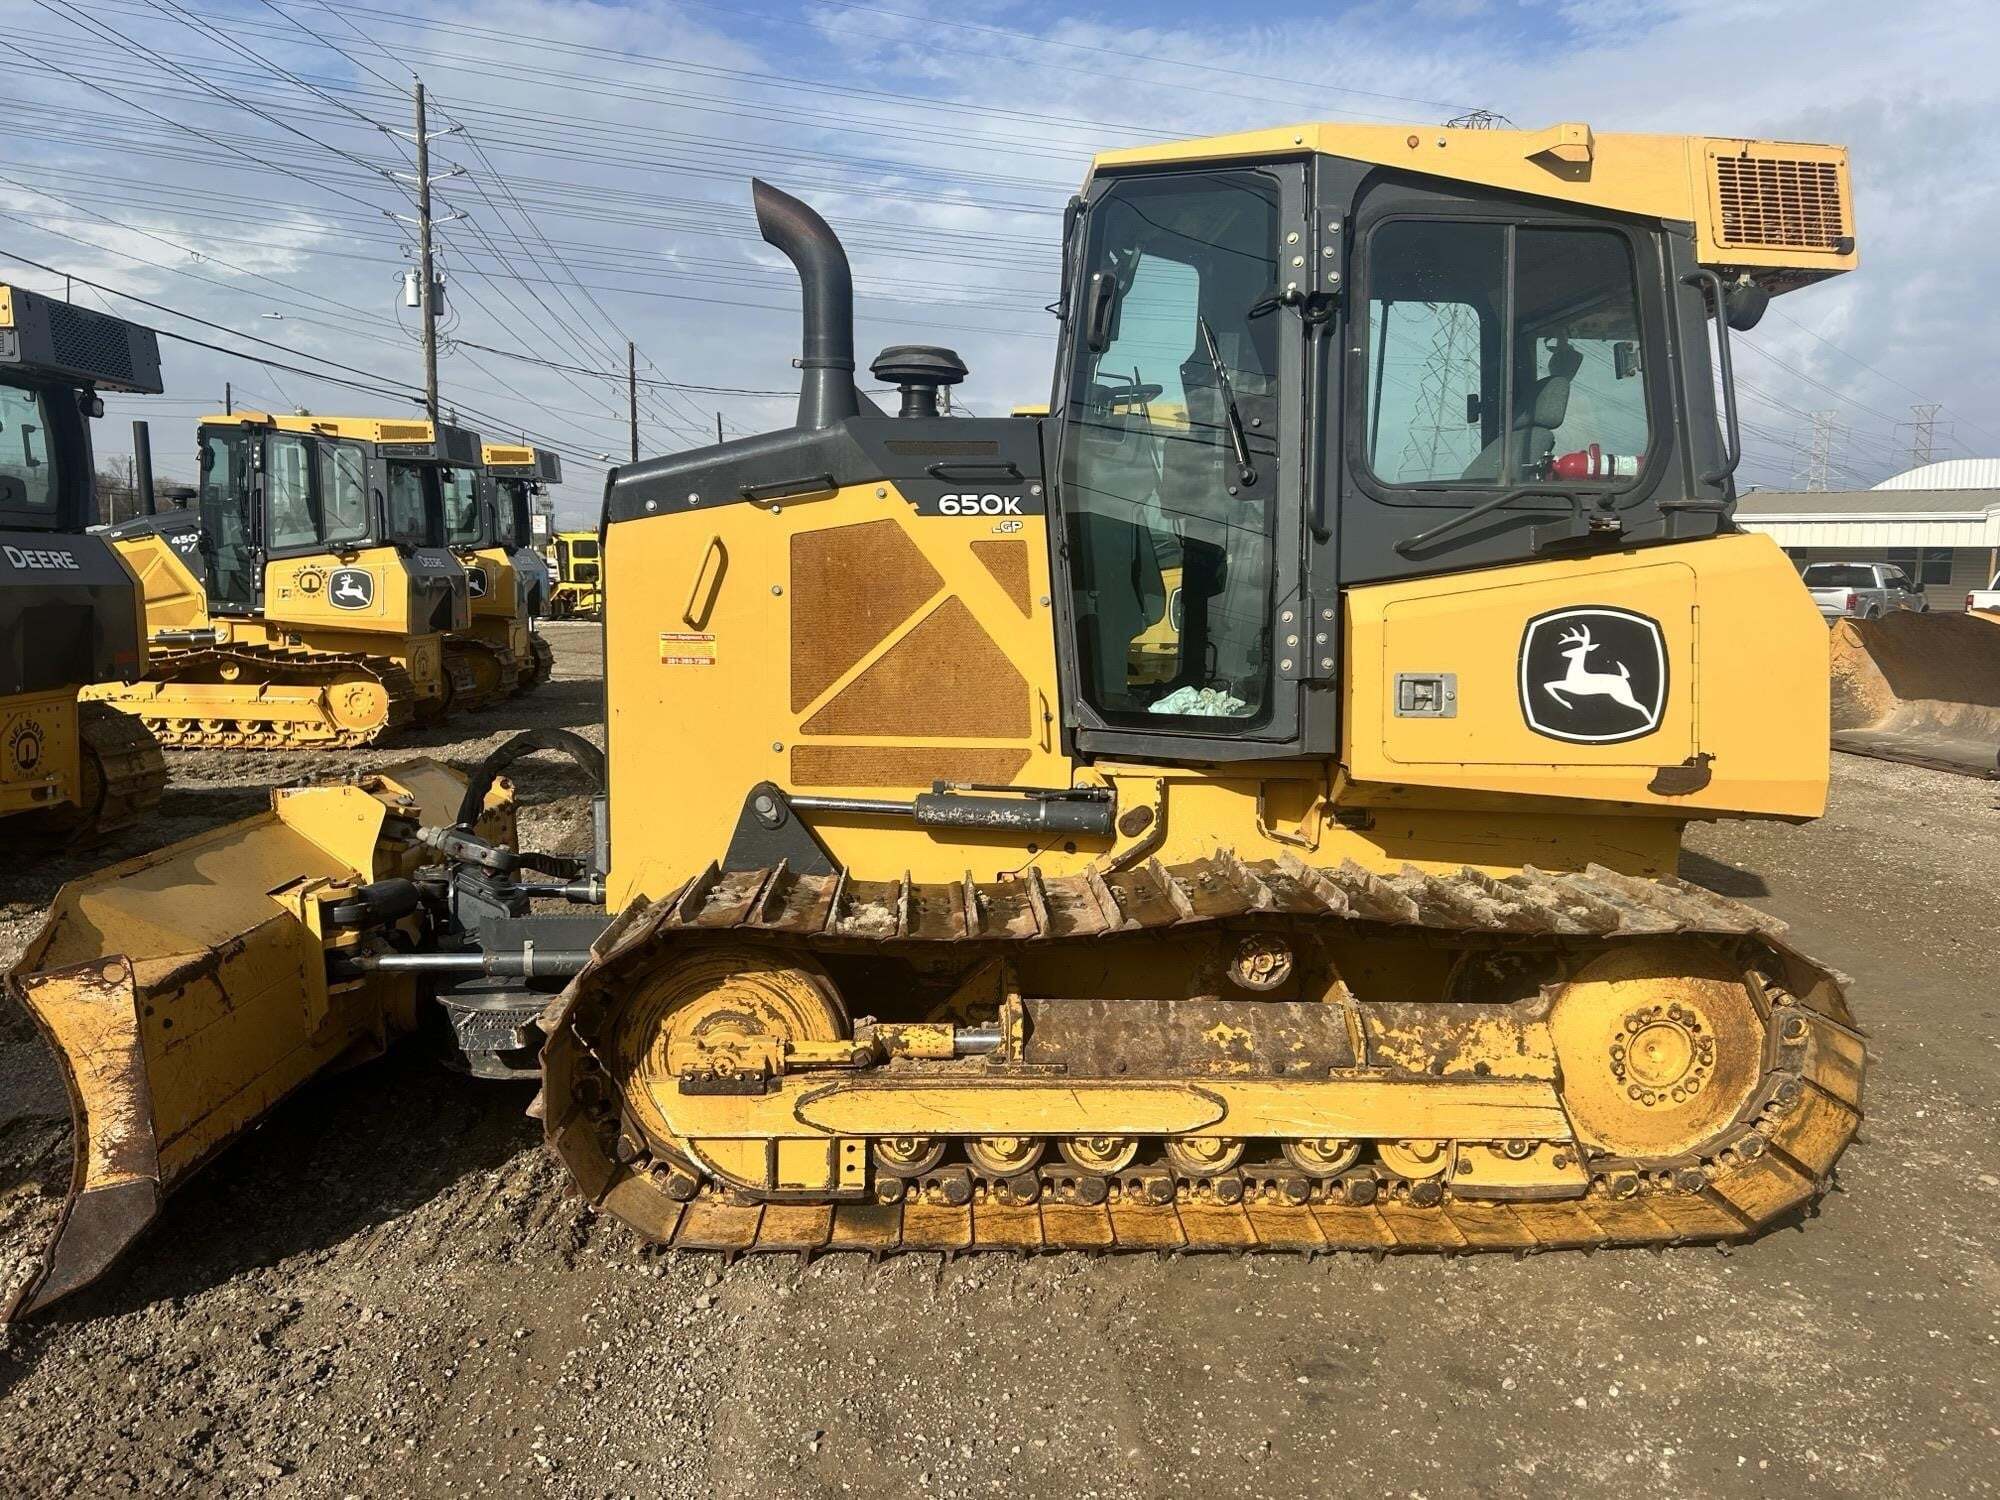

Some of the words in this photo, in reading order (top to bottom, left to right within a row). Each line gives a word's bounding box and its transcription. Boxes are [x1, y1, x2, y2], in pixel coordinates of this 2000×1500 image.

[939, 494, 1023, 515] 650K
[171, 533, 198, 545] 450
[2, 545, 80, 569] DEERE
